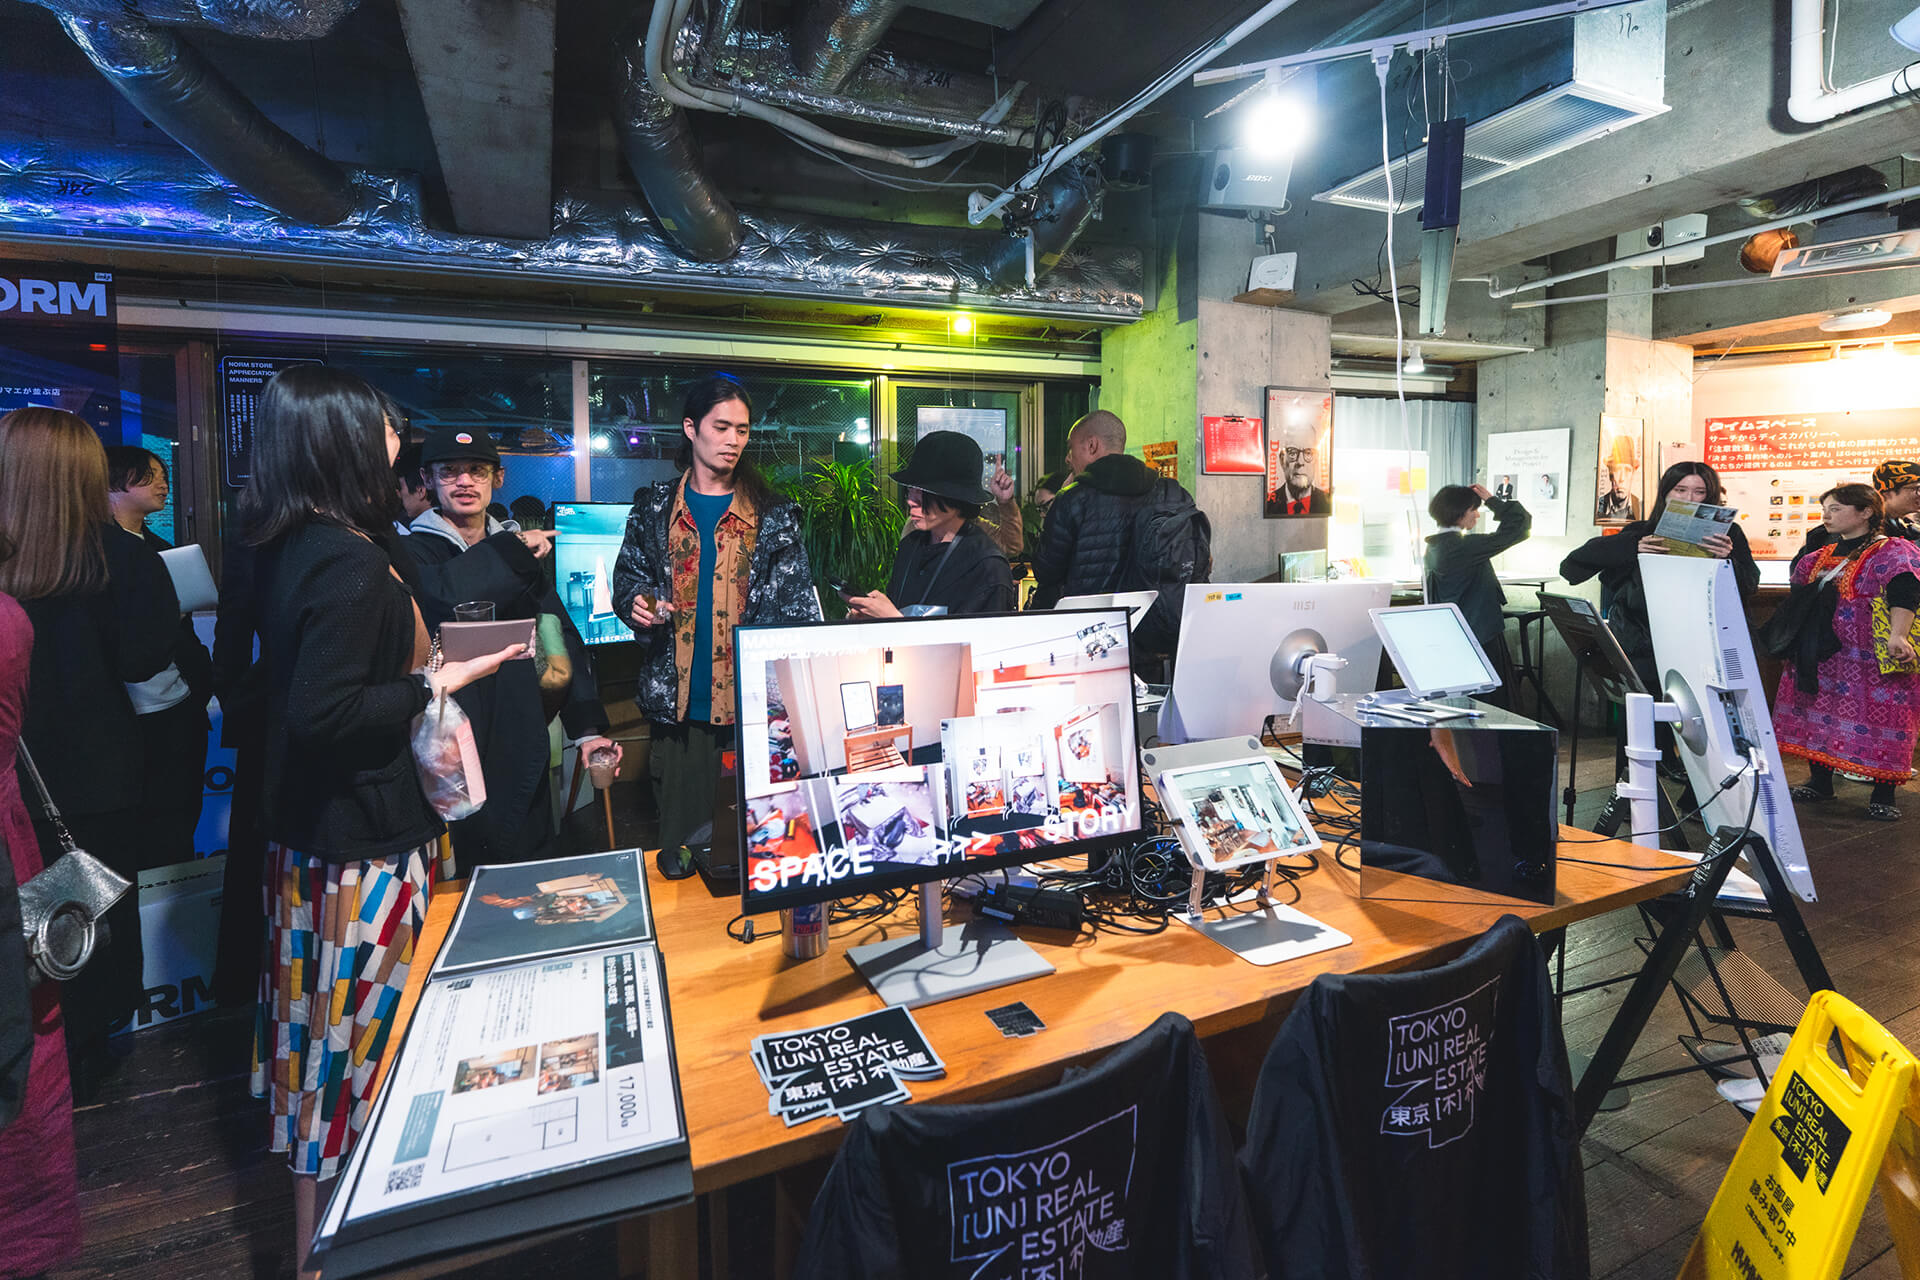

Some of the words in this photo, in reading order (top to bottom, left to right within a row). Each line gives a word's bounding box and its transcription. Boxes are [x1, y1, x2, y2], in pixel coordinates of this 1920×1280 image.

[56, 179, 96, 196] 24K
[228, 361, 250, 369] NORM
[1709, 417, 1817, 432] タイムスペース
[1268, 439, 1280, 503] Deming
[753, 844, 874, 893] SPACE
[1043, 801, 1137, 842] STORY
[769, 1026, 850, 1054] TOKYO
[1396, 1007, 1467, 1046] TOKYO
[773, 1048, 824, 1070] [UN]
[828, 1032, 887, 1058] REAL
[824, 1040, 909, 1076] ESTATE
[1395, 1041, 1439, 1076] [UN]
[1443, 1023, 1481, 1060] REAL
[1434, 1041, 1487, 1090] ESTATE
[784, 1081, 826, 1102] 東京
[1790, 1075, 1825, 1118] TOKYO
[1388, 1102, 1431, 1127] 東京
[1804, 1113, 1828, 1147] REAL
[1793, 1121, 1830, 1168] ESTATE
[958, 1151, 1071, 1204] TOKYO
[1764, 1173, 1795, 1218] お部屋
[962, 1197, 1027, 1244] [UN]
[1036, 1169, 1100, 1223] REAL
[1021, 1191, 1114, 1261] ESTATE
